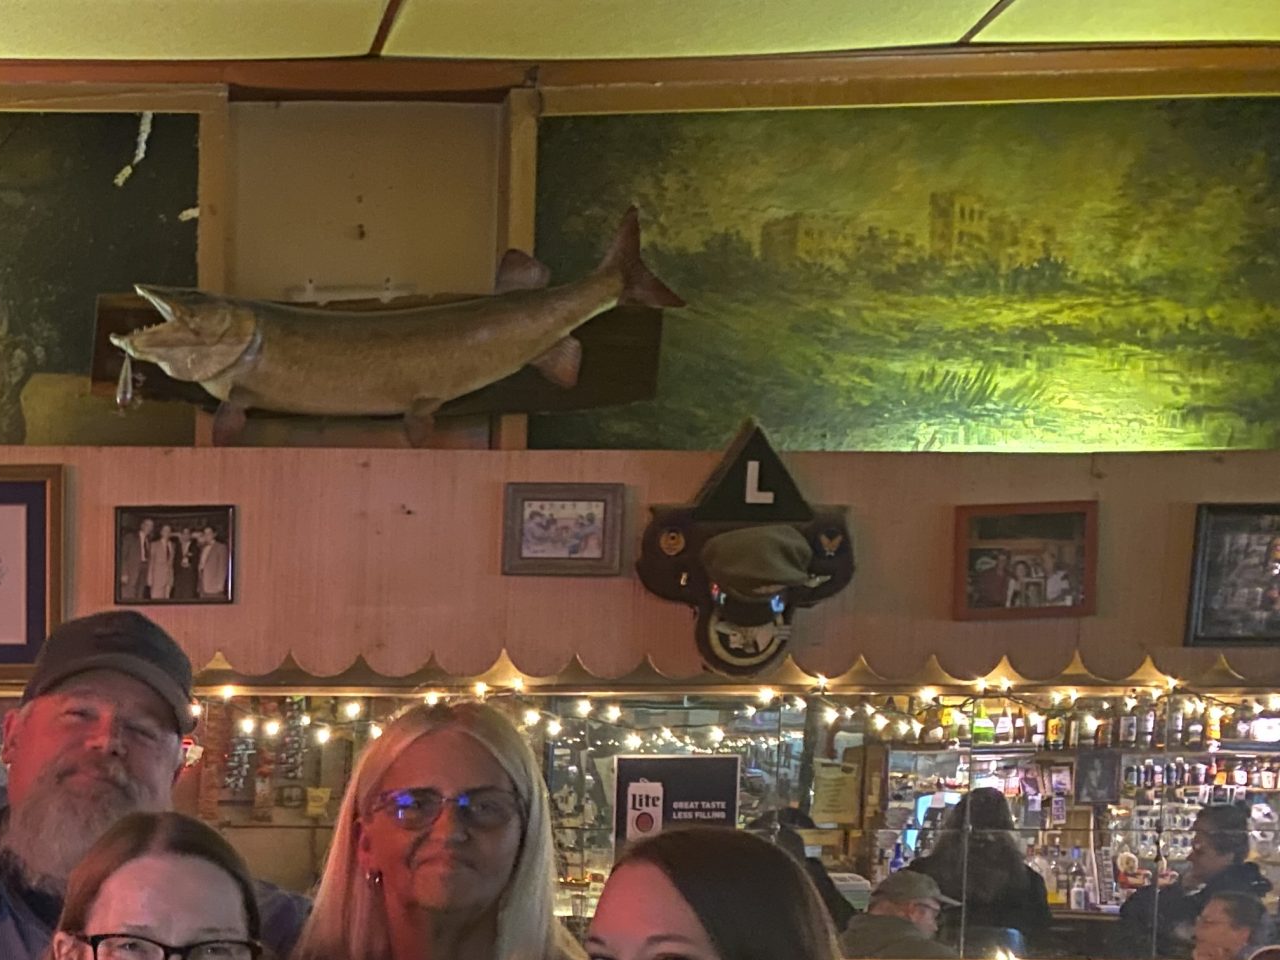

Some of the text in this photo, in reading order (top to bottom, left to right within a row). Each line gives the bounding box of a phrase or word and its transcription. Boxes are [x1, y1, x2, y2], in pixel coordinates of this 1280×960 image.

[745, 460, 774, 504] L
[631, 793, 661, 811] Lite
[672, 801, 727, 810] GREAT TASTE
[672, 811, 727, 820] LESS FILLING
